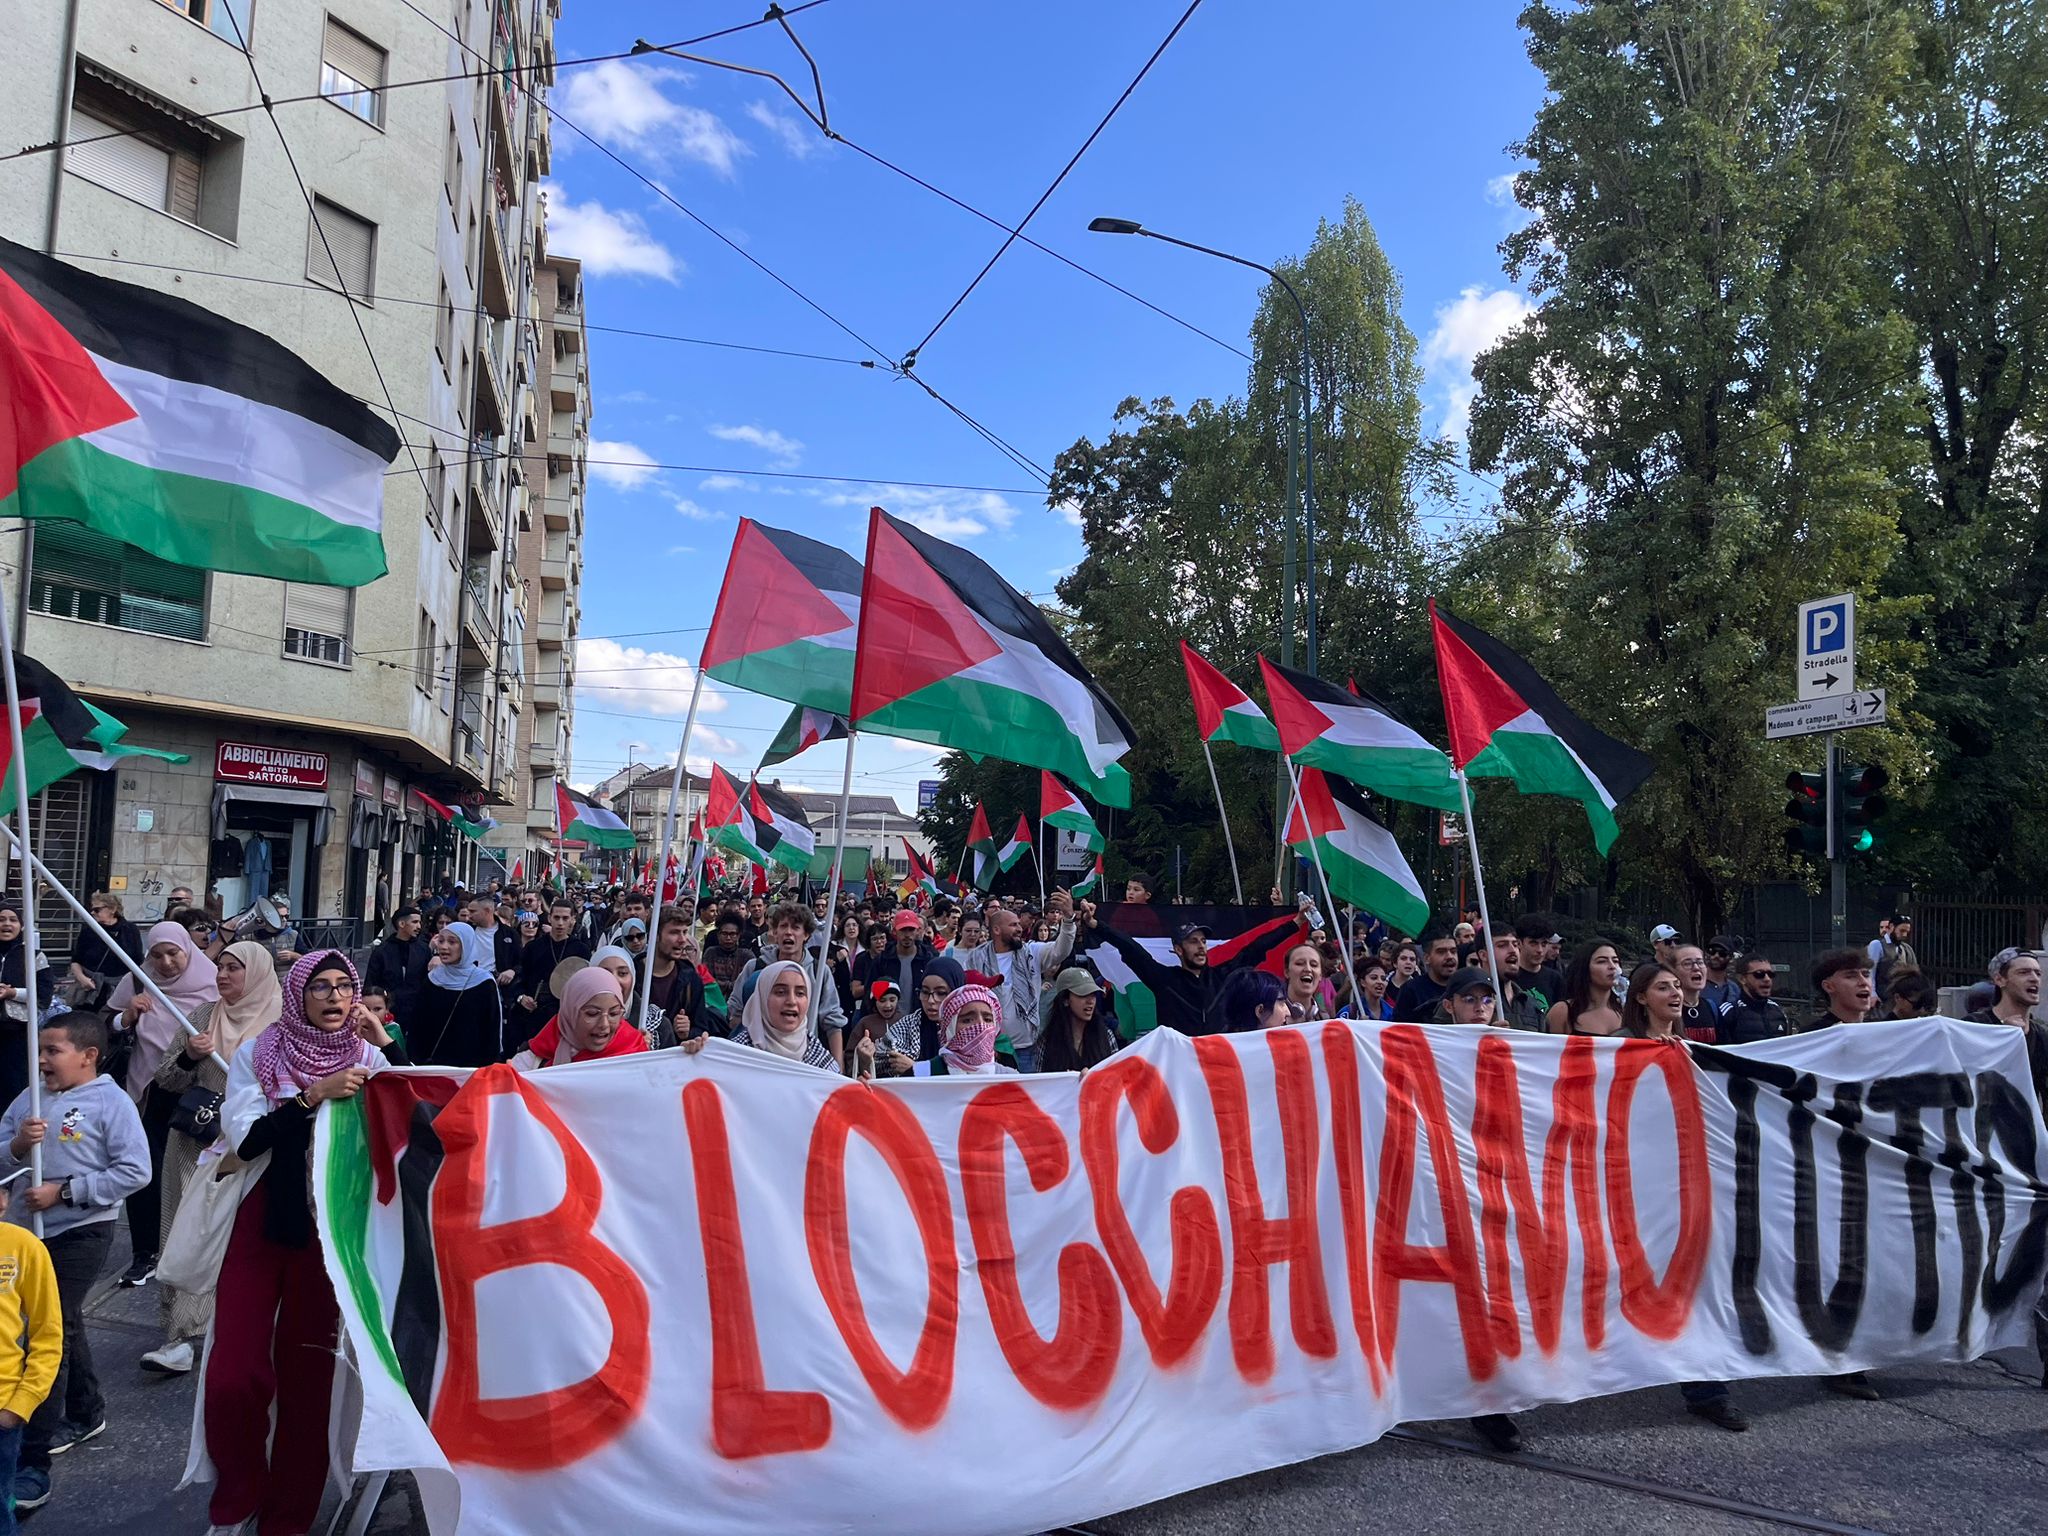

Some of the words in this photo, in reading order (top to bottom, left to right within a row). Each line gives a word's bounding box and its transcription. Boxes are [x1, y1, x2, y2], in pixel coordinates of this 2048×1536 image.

[1813, 610, 1838, 650] P
[1804, 655, 1848, 669] Stradella
[1768, 703, 1812, 716] commissariato
[1768, 720, 1794, 730] Madonna
[1797, 717, 1803, 726] di
[1805, 713, 1838, 725] campagna
[223, 745, 324, 771] ABBIGLIAMENTO
[248, 770, 299, 784] SARTORIA
[261, 765, 289, 774] ABITO
[428, 1020, 1714, 1472] BLOCCHIAMO
